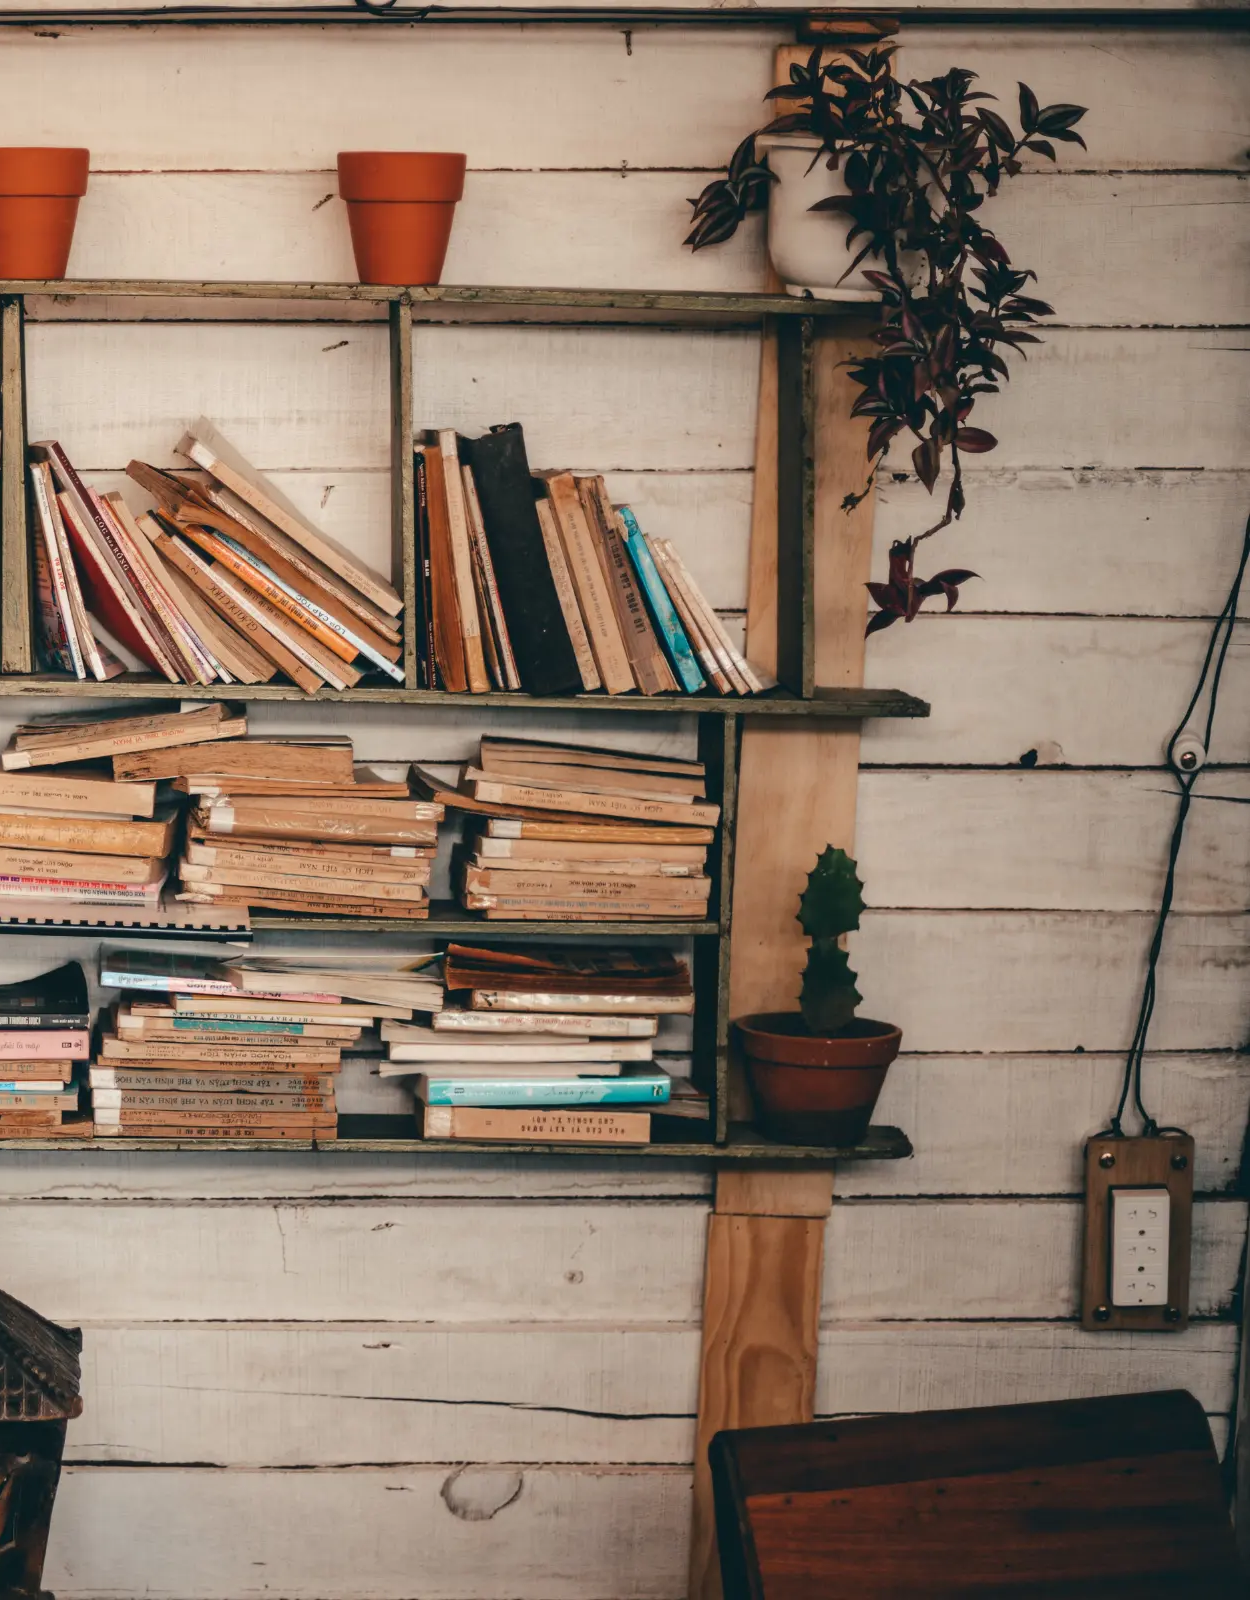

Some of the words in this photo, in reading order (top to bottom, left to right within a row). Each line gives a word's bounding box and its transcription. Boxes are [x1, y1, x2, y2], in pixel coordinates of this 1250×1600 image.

[310, 609, 328, 623] CẤP
[633, 616, 646, 633] LAO
[328, 622, 346, 636] LỚP
[588, 799, 606, 807] NAM
[610, 802, 626, 810] VIỆT
[355, 867, 373, 875] LỊCH
[0, 1040, 14, 1050] phải
[25, 1043, 40, 1051] mập
[232, 1078, 253, 1086] NGHỊ
[158, 1097, 177, 1105] BÌNH
[180, 1098, 195, 1106] PHÊ
[236, 1097, 256, 1106] NGHỊ
[260, 1098, 274, 1106] TẬP
